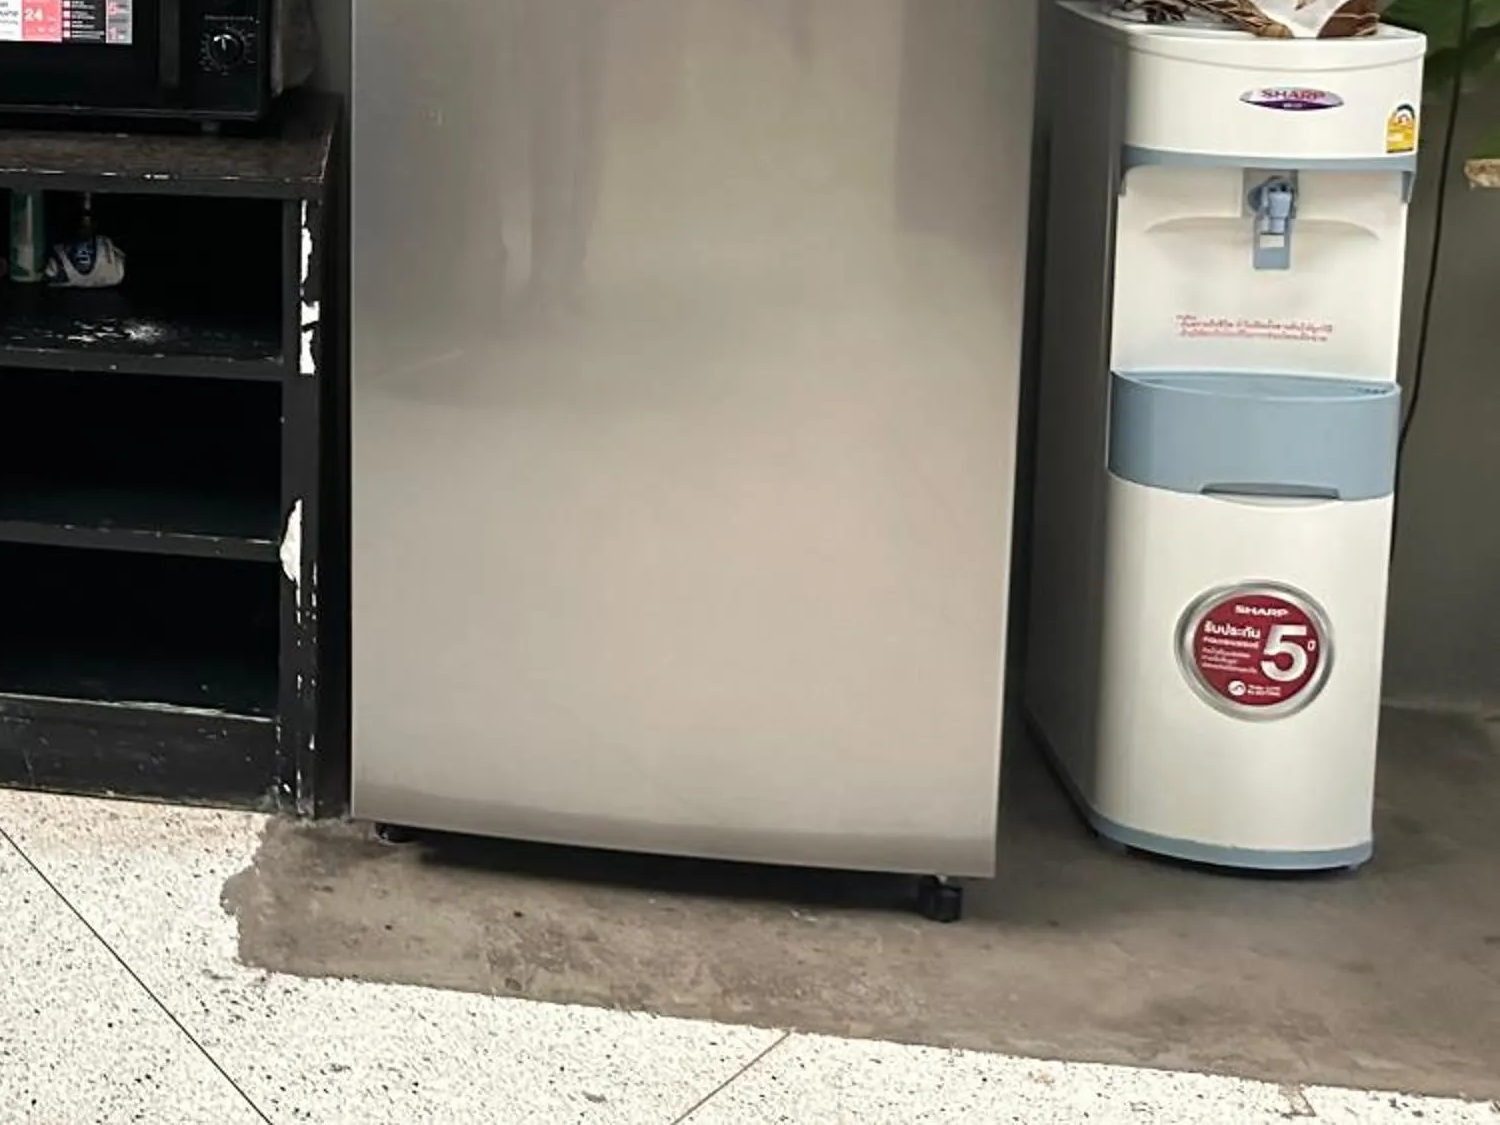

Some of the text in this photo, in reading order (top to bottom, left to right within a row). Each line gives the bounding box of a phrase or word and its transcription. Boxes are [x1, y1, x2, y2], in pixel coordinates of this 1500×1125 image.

[24, 7, 44, 22] 24
[1261, 89, 1326, 100] SHARP
[1235, 605, 1289, 617] SHARP
[1261, 624, 1308, 682] 5
